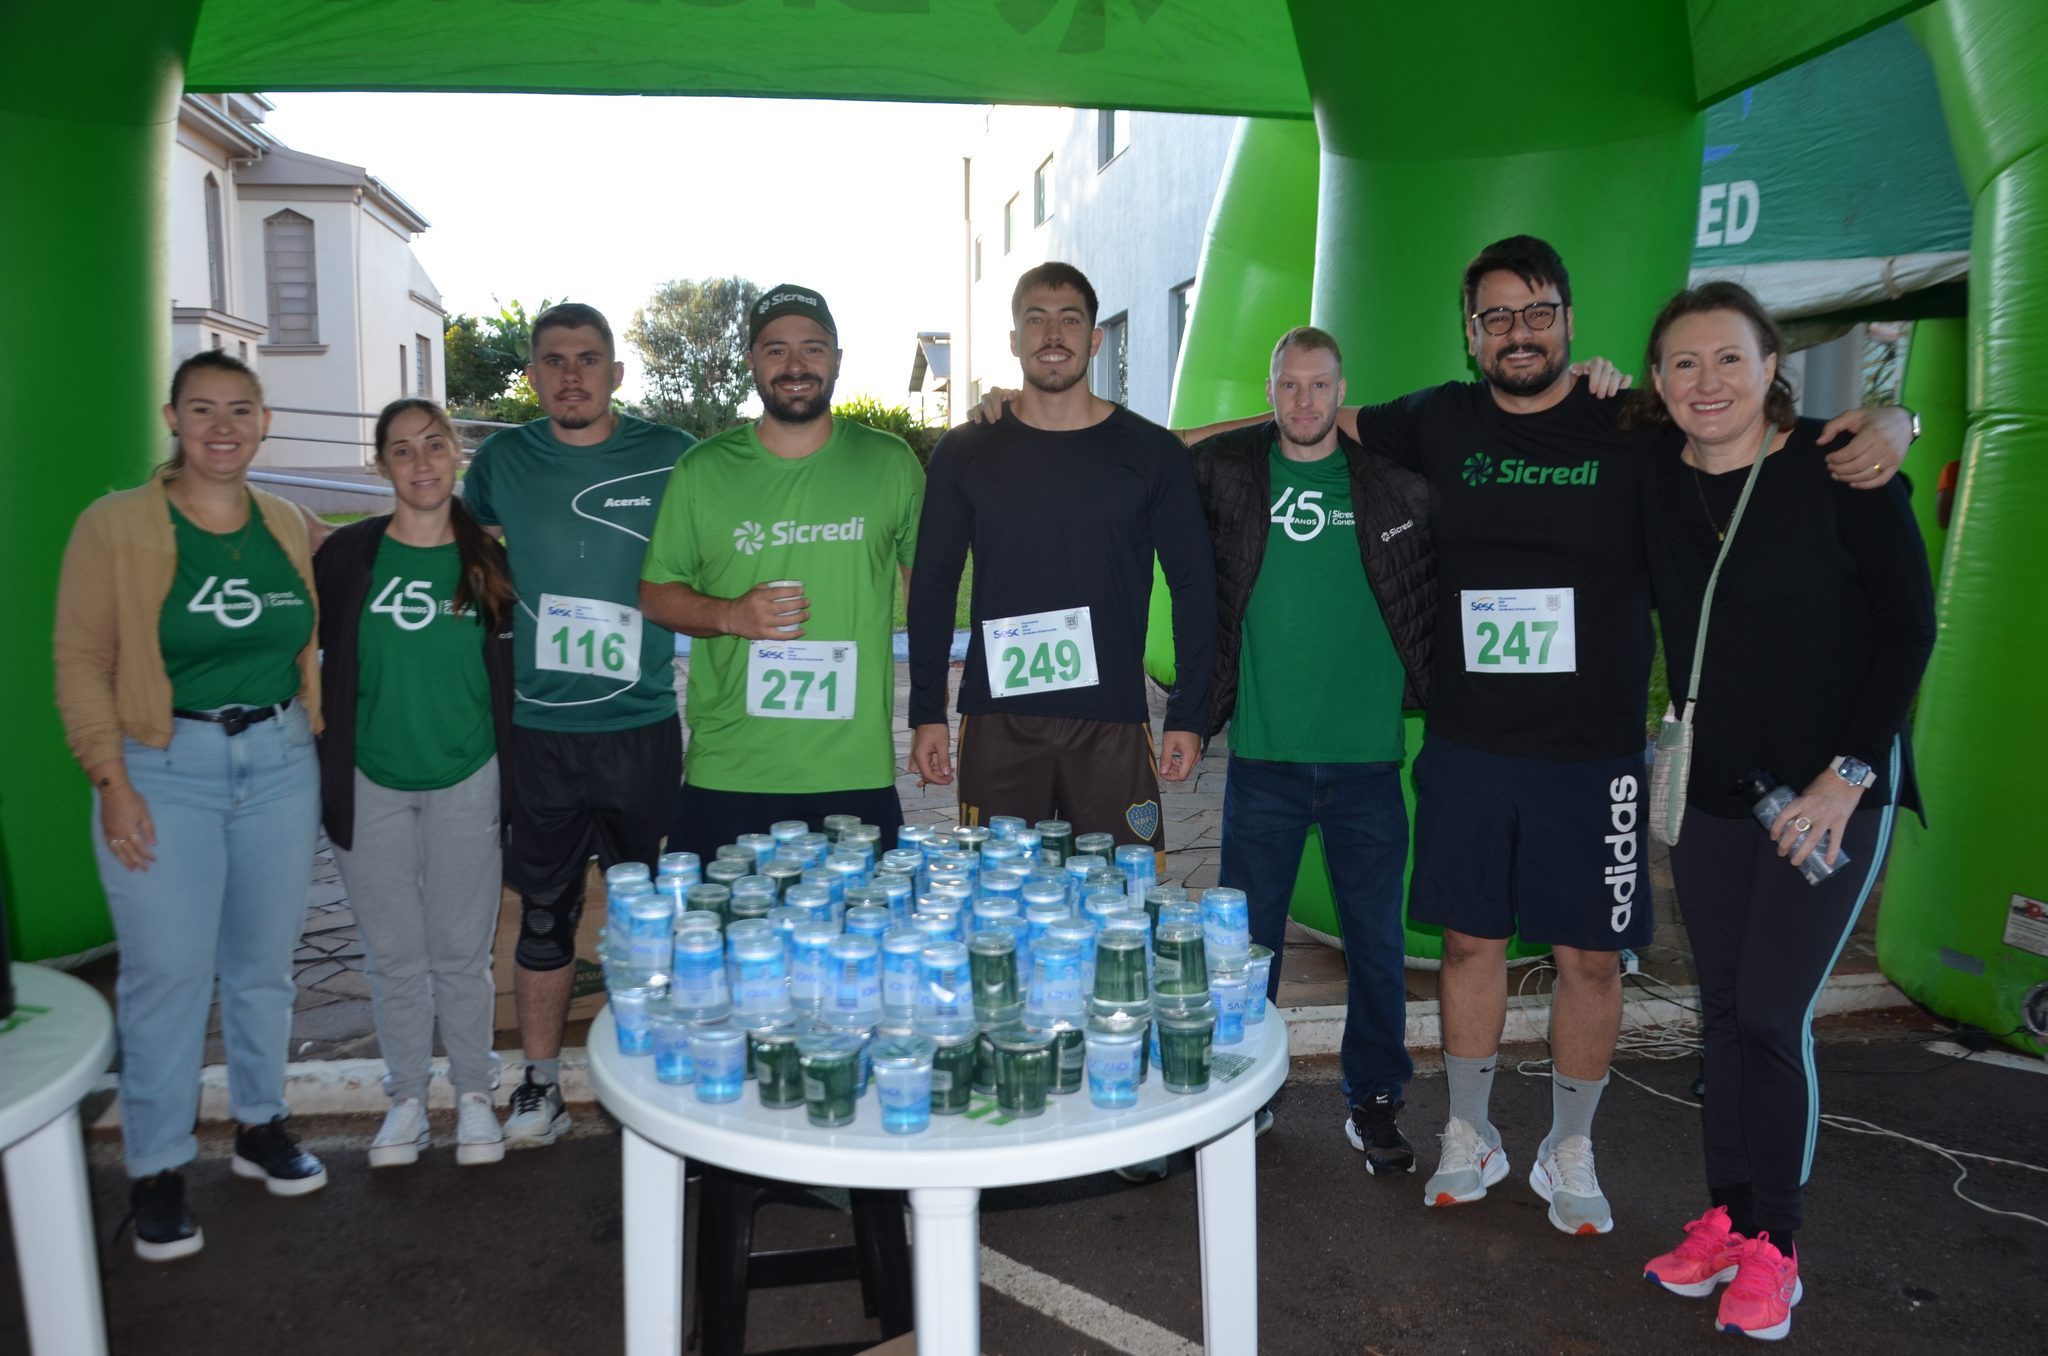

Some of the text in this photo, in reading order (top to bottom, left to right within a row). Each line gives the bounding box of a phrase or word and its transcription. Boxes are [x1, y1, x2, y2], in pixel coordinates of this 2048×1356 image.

[771, 292, 817, 307] Sicredi
[1496, 459, 1599, 485] Sicredi
[604, 496, 651, 508] Acersic
[1270, 486, 1326, 542] 45
[771, 517, 865, 546] Sicredi
[1389, 519, 1414, 538] Sicredi
[187, 575, 262, 628] 45
[370, 576, 437, 631] 45
[552, 626, 626, 672] 116
[1002, 639, 1082, 689] 249
[1476, 621, 1559, 665] 247
[760, 668, 837, 712] 271
[1605, 775, 1638, 932] adidas
